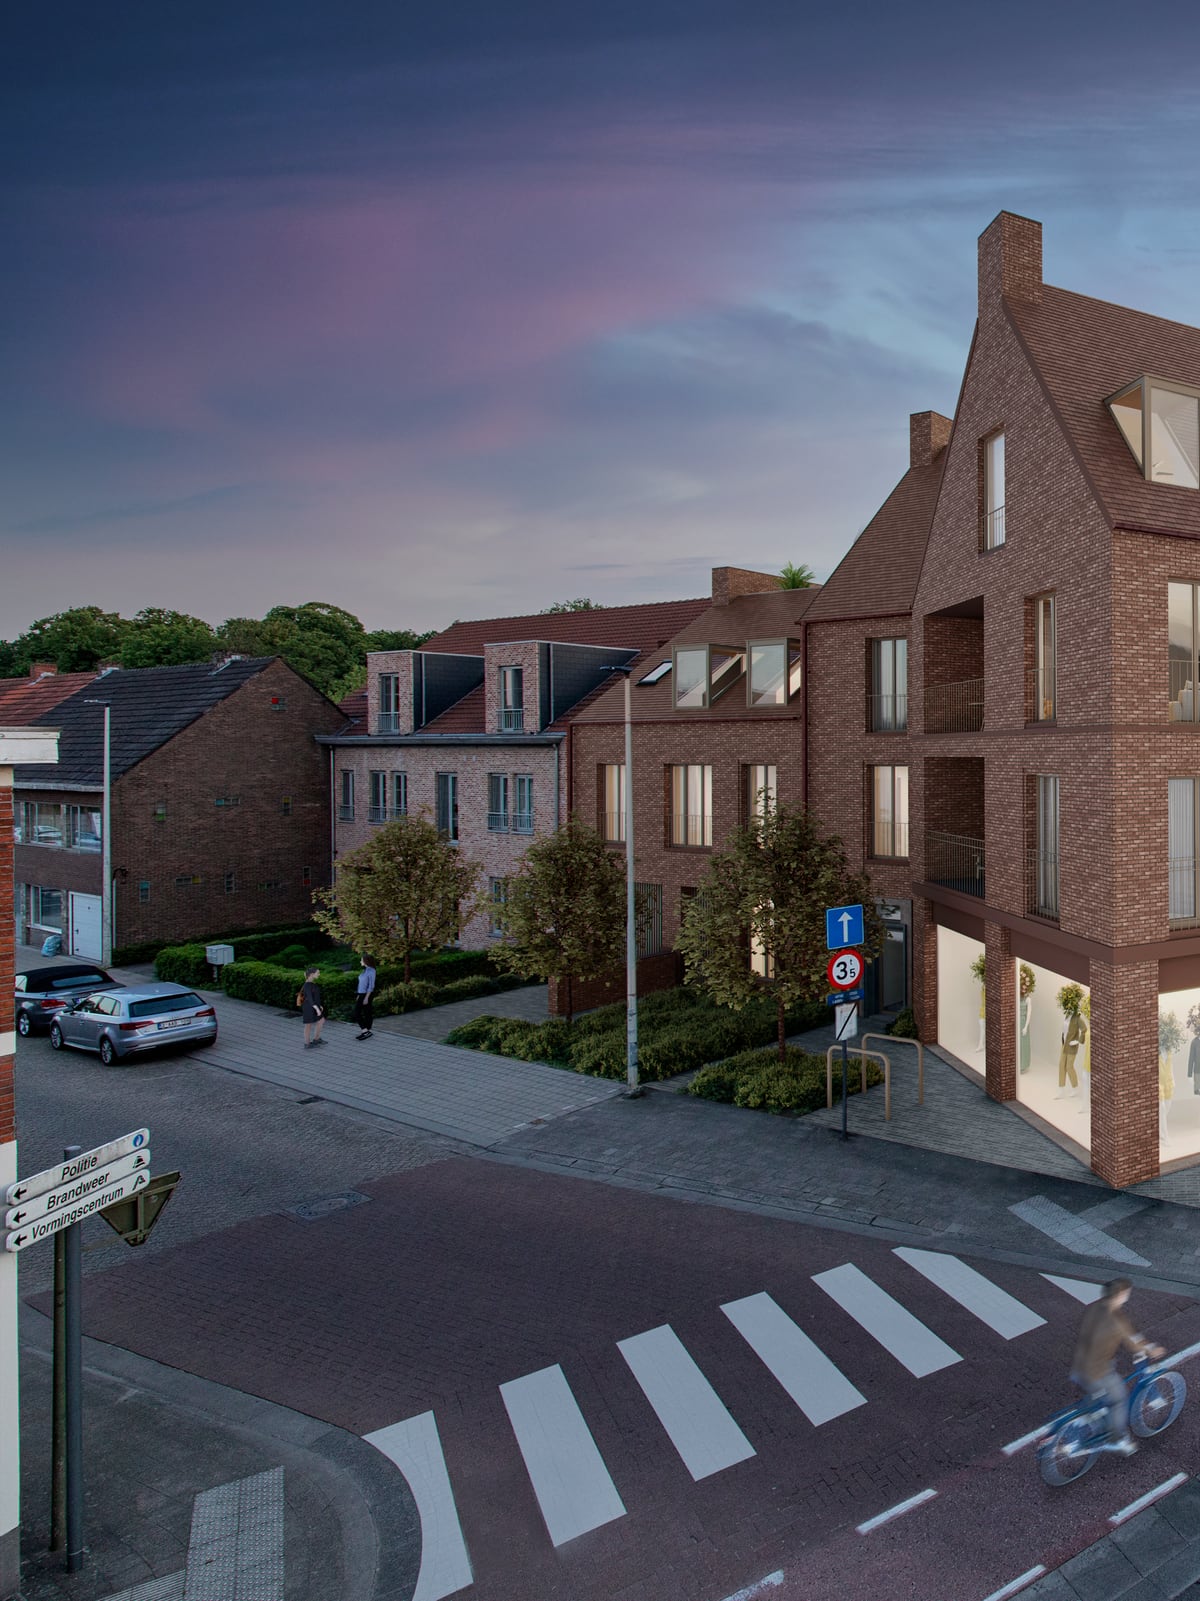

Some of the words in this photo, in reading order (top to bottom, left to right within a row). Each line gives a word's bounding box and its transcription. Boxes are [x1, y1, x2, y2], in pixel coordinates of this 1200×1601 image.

[61, 1155, 98, 1181] Politie
[46, 1171, 110, 1211] Brandweer
[32, 1185, 124, 1240] Vormingscentrum
